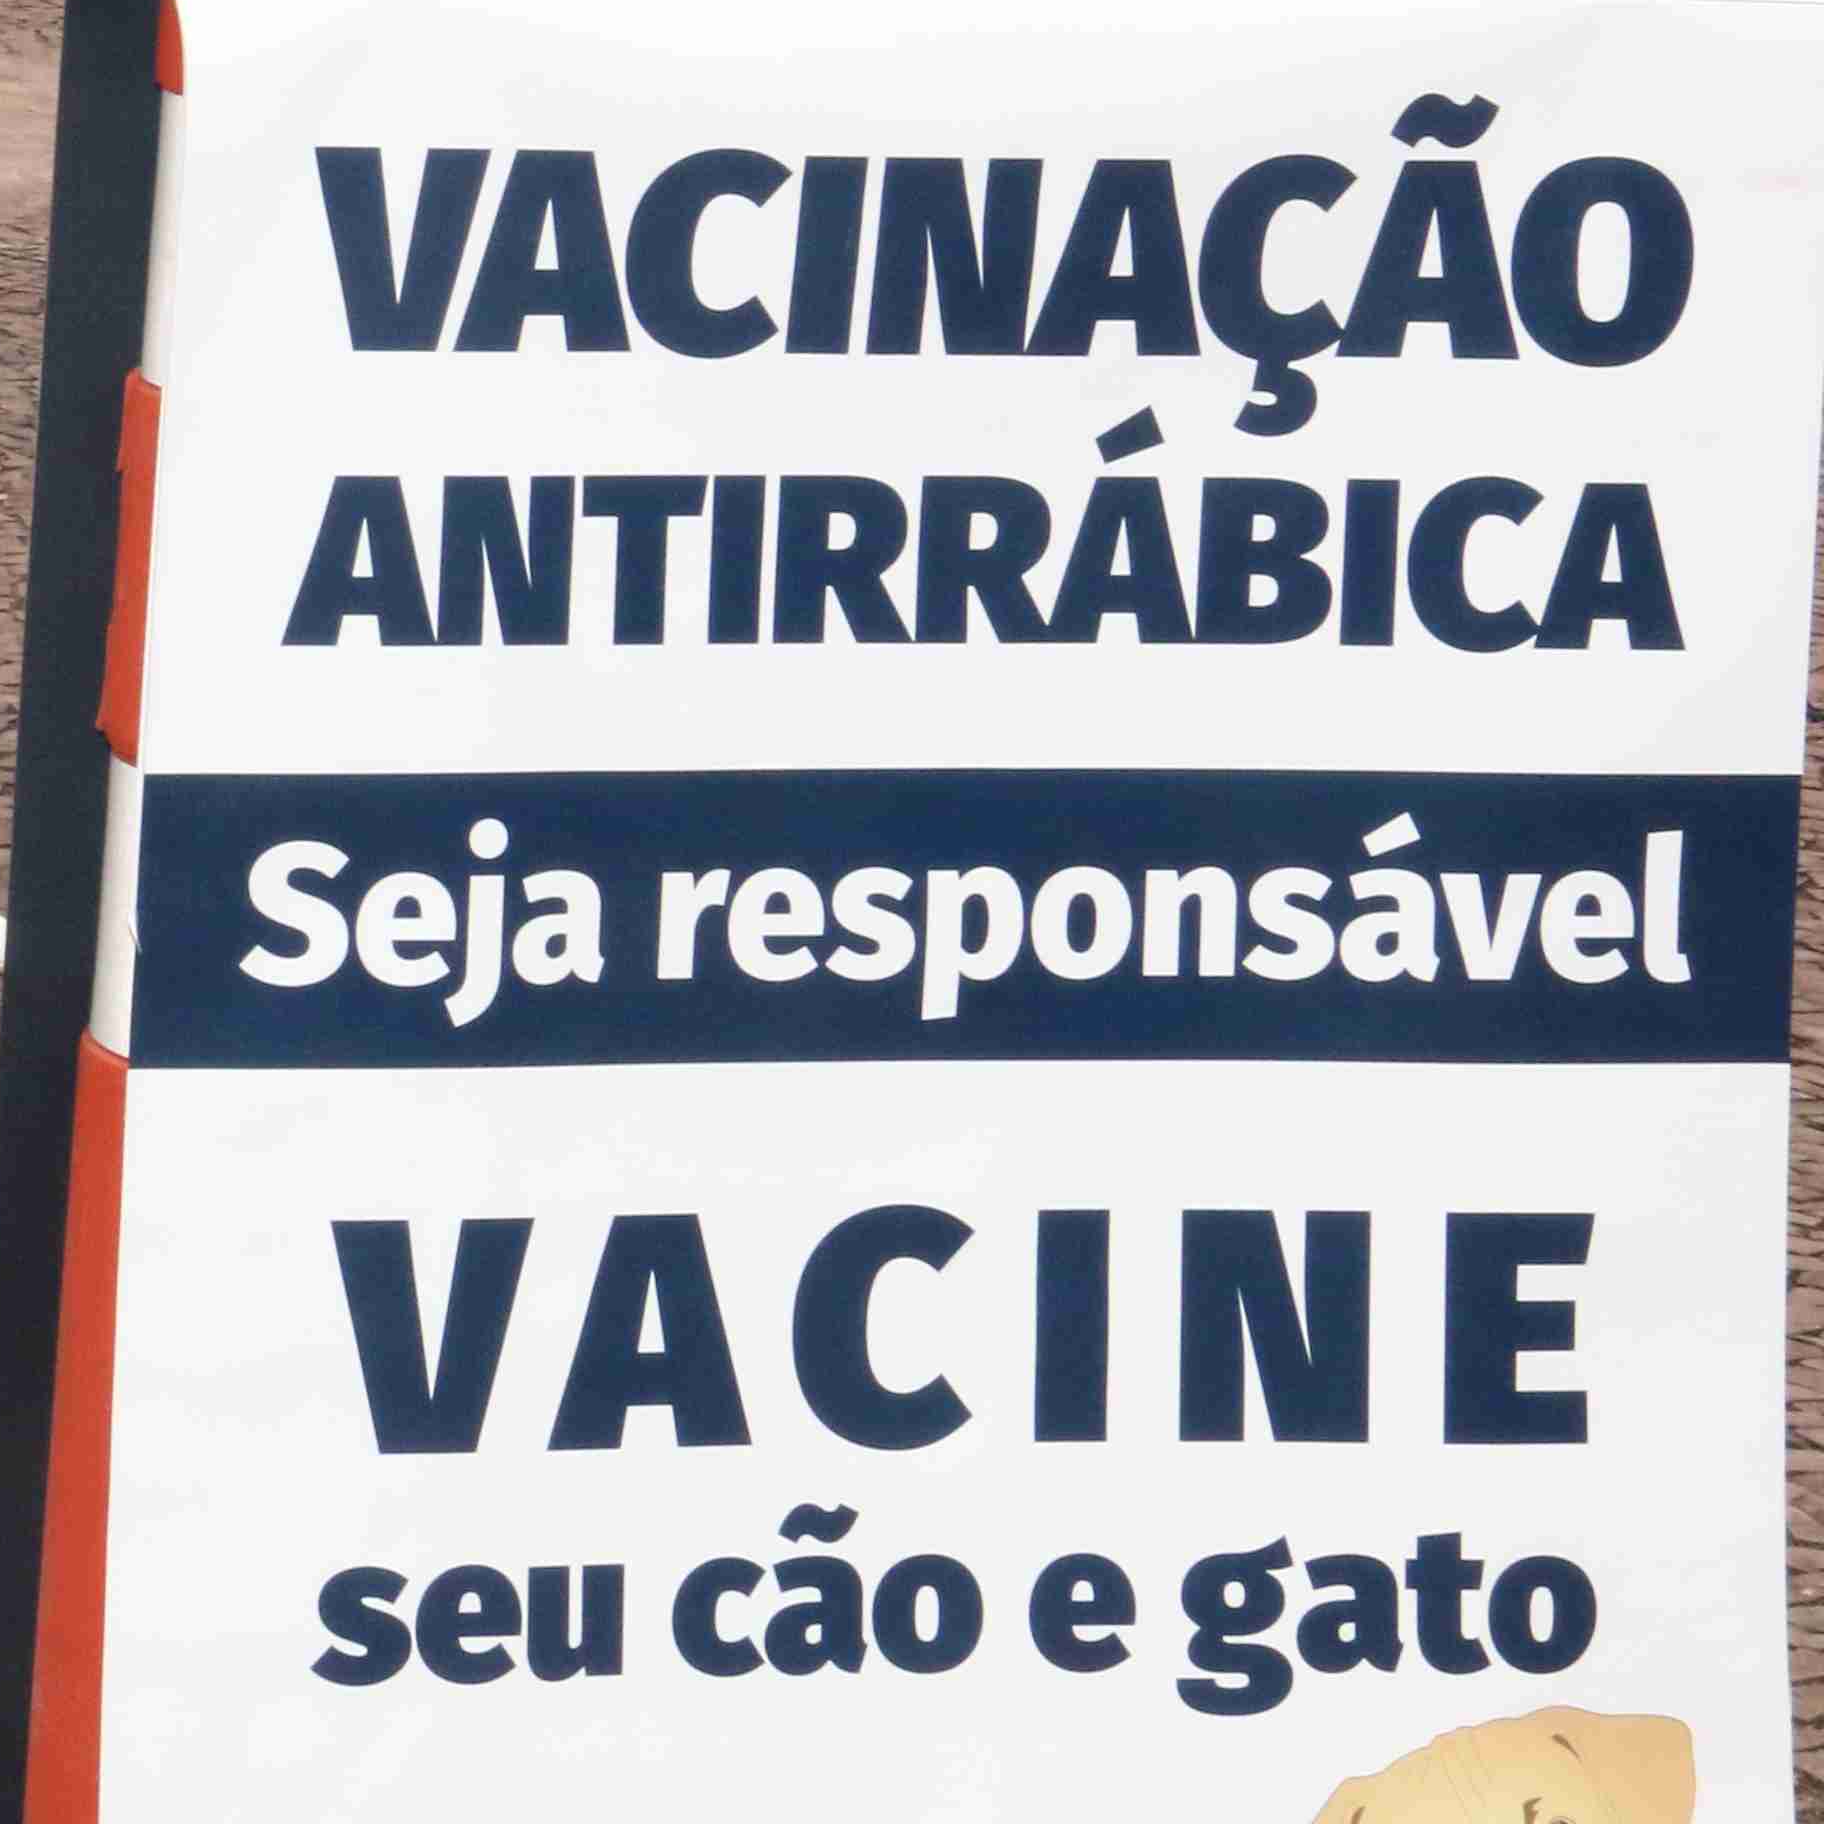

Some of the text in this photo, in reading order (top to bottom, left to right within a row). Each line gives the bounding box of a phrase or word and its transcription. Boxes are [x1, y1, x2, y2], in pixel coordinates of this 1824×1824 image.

[314, 93, 1694, 438] VACINAÇÃO
[282, 407, 1685, 652] ANTIRRÁBICA
[238, 811, 1691, 1028] Seja responsável
[331, 1204, 1594, 1454] VACINE
[311, 1503, 1597, 1716] seu cão e gato
